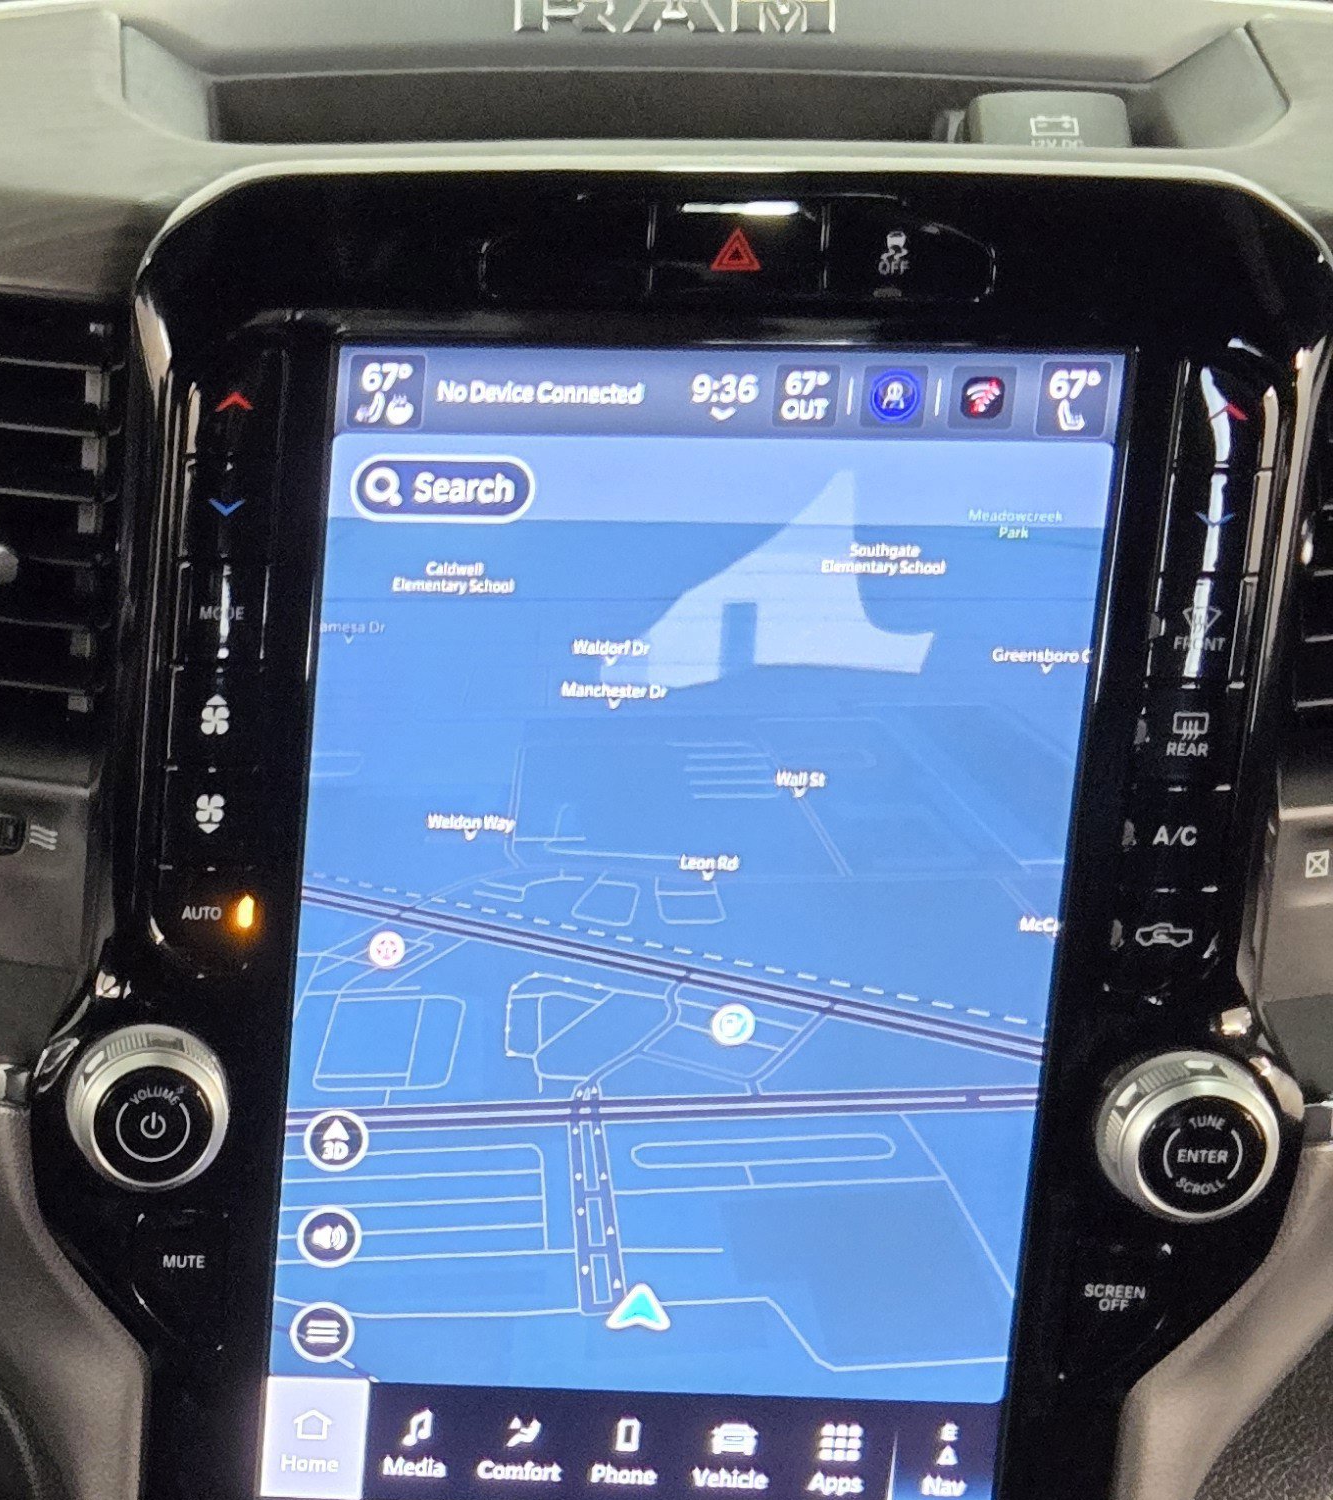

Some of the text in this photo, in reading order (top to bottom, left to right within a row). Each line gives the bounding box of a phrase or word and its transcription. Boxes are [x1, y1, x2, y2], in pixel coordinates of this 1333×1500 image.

[878, 260, 910, 275] OFF
[437, 380, 645, 405] No Device Connected
[692, 373, 759, 404] 9:36
[780, 397, 830, 421] OUT
[414, 471, 515, 504] Search
[998, 525, 1029, 540] Park
[850, 544, 921, 560] Southgate
[426, 561, 484, 577] Caldwell
[821, 559, 947, 577] Elementary School
[392, 577, 515, 595] Elementary School
[368, 621, 385, 634] Dr
[572, 640, 650, 657] Waldorf Dr
[992, 647, 1080, 665] Greensboro
[560, 681, 667, 699] Manchester Dr
[1166, 742, 1209, 758] REAR
[775, 770, 827, 788] Wall St
[426, 814, 516, 834] Weldon Way
[1152, 825, 1197, 847] A/C
[679, 854, 740, 871] Leon Rd
[181, 905, 222, 922] AUTO
[129, 1086, 182, 1107] VOLUME
[1187, 1114, 1228, 1132] TUNE
[321, 1142, 349, 1162] 3D
[1177, 1149, 1229, 1165] ENTER
[1175, 1177, 1226, 1196] SCROLL
[162, 1254, 206, 1270] MUTE
[1084, 1283, 1146, 1300] SCREEN
[1098, 1299, 1130, 1312] OFF
[280, 1454, 339, 1474] Home
[382, 1455, 447, 1478] Media
[476, 1459, 563, 1482] Comfort
[590, 1463, 658, 1487] Phone
[692, 1466, 769, 1490] Vehicle
[807, 1470, 864, 1497] Apps
[921, 1474, 968, 1497] Nav
